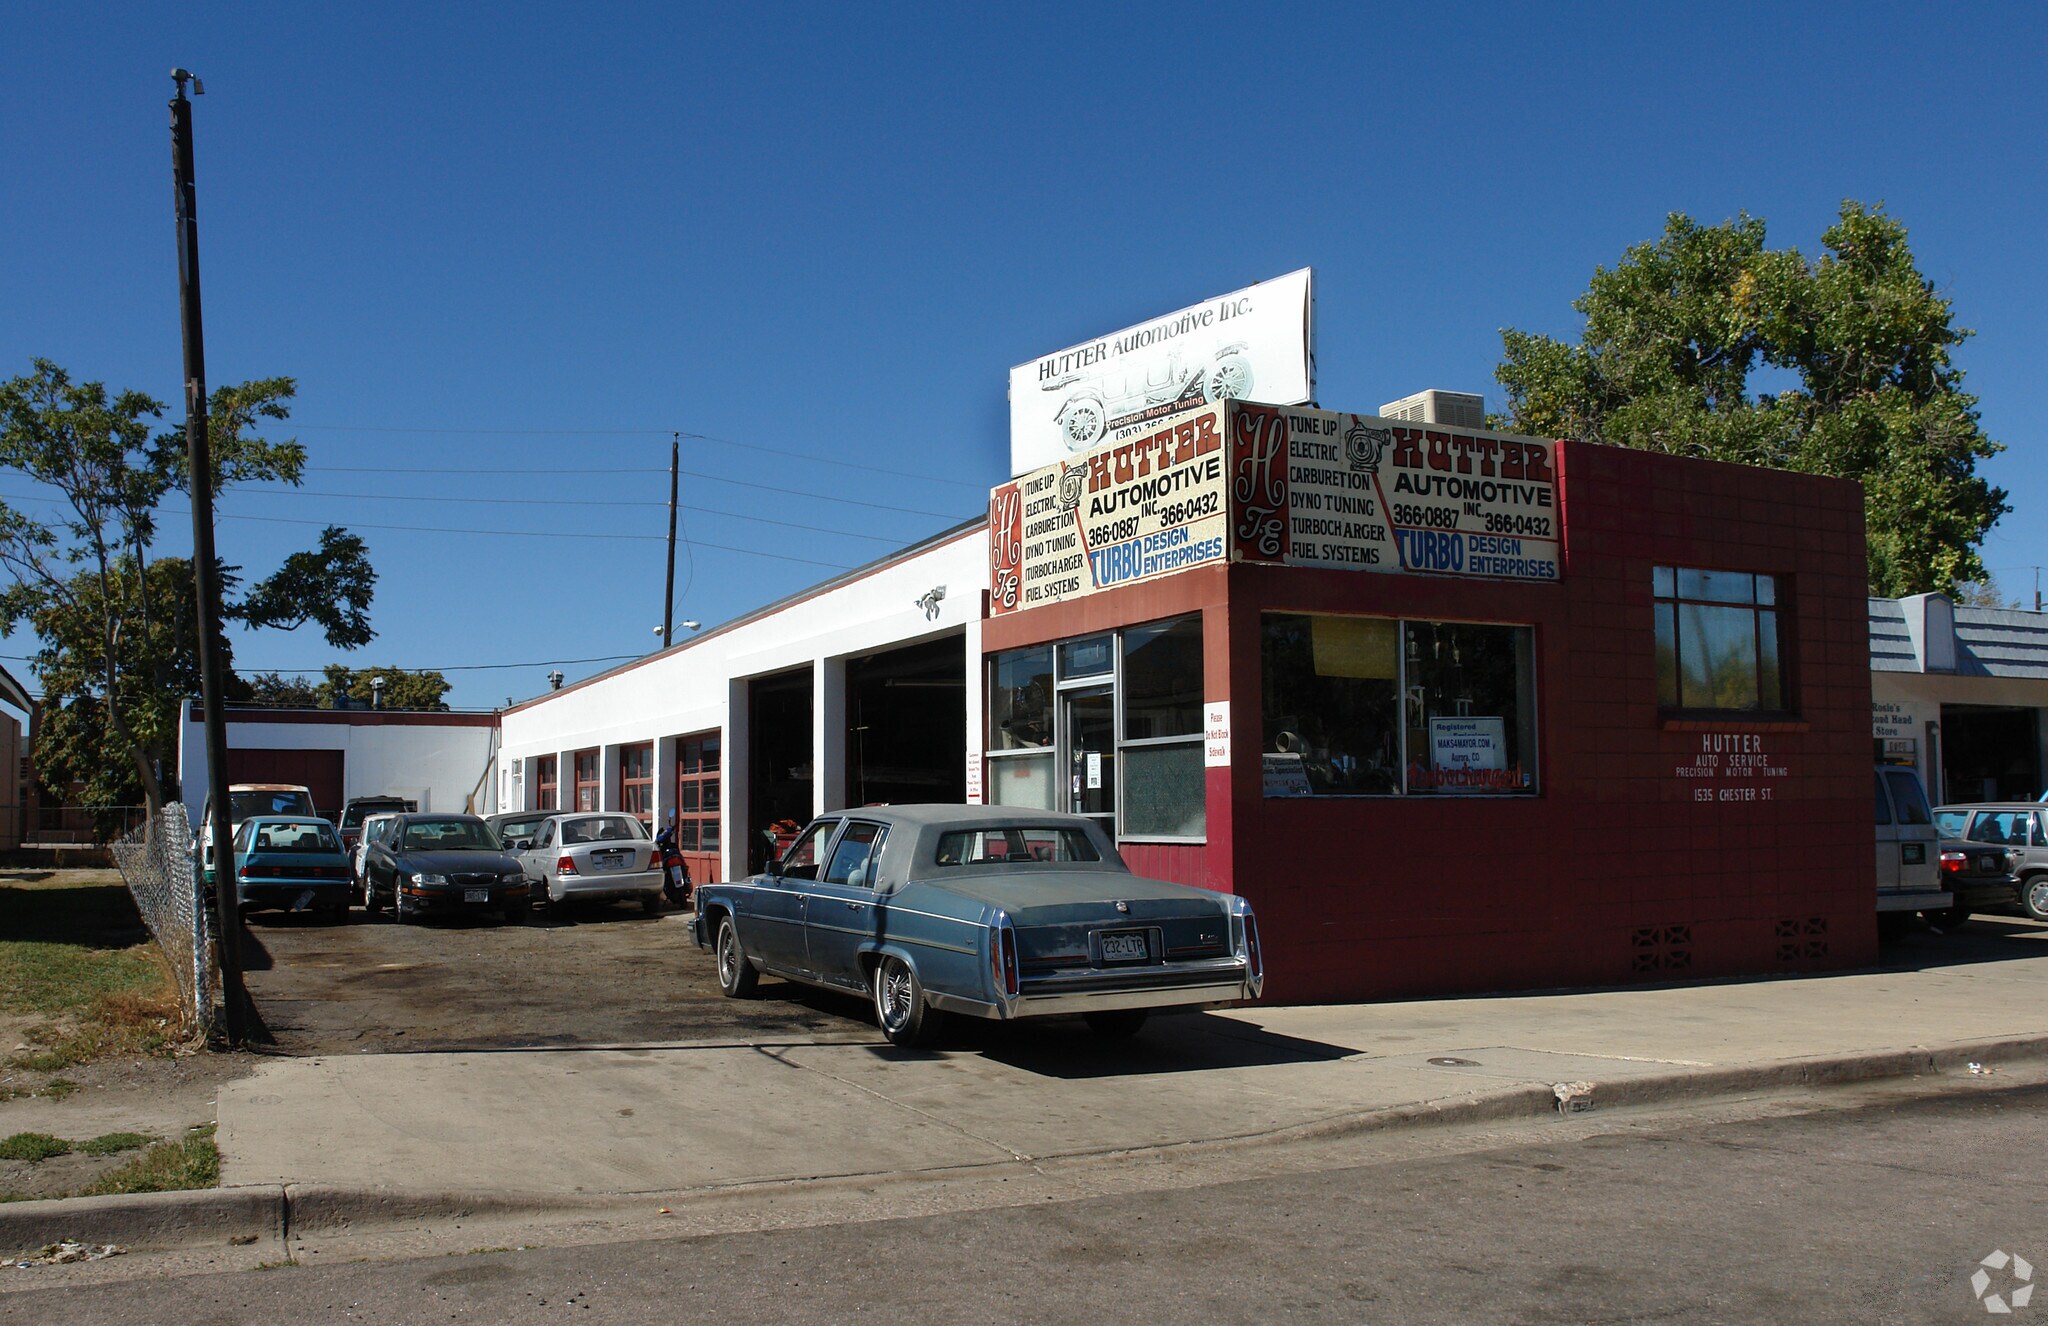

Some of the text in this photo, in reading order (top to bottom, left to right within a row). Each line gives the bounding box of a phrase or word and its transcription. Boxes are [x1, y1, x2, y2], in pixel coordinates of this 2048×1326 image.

[1039, 297, 1253, 381] HUTTER Automotive Inc.
[1106, 413, 1144, 429] Precision
[1147, 405, 1172, 418] Motor
[1174, 396, 1204, 410] Tuning
[1289, 415, 1337, 436] TUNE UP
[1089, 411, 1221, 493] HUTTER
[1290, 442, 1338, 462] ELECTRIC
[1391, 426, 1553, 483] HUTTER
[1025, 473, 1054, 497] TUNE UP
[1089, 457, 1220, 518] AUTOMOTIVE
[1290, 465, 1370, 491] CARBURETION
[1394, 473, 1552, 507] AUTOMOTIVE
[1026, 495, 1056, 518] ELECTRIC
[1141, 500, 1160, 518] INC.
[1290, 491, 1374, 517] DYNO TUNING
[1463, 502, 1484, 518] INC.
[1026, 511, 1074, 539] CARBURETION
[1291, 517, 1385, 541] TURBOCHARGER
[1026, 533, 1076, 560] DYNO TUNING
[1144, 526, 1188, 553] DESIGN
[1395, 529, 1463, 571] TURBO
[1469, 535, 1521, 555] DESIGN
[1089, 539, 1142, 586] TURBO
[1144, 537, 1222, 574] ENTERPRISES
[1292, 541, 1379, 564] FUEL SYSTEMS
[1026, 553, 1083, 581] TURBOCHARGER
[1469, 555, 1555, 578] ENTERPRISES
[1026, 576, 1079, 602] FUEL SYSTEMS
[1211, 713, 1223, 723] Please
[1872, 702, 1900, 713] Rosie's
[1436, 723, 1476, 731] Registered
[1875, 726, 1898, 736] Store
[1891, 715, 1912, 724] Hand
[1218, 728, 1229, 739] Block
[1437, 739, 1490, 748] MAKS4MAYOR.COM
[1703, 734, 1761, 753] HUTTER
[1472, 752, 1480, 761] CO
[1696, 754, 1768, 767] AUTO SERVICE
[1676, 767, 1788, 777] PRECISION MOTOR TUNING
[1694, 788, 1713, 801] 1535
[1719, 788, 1756, 801] CHESTER
